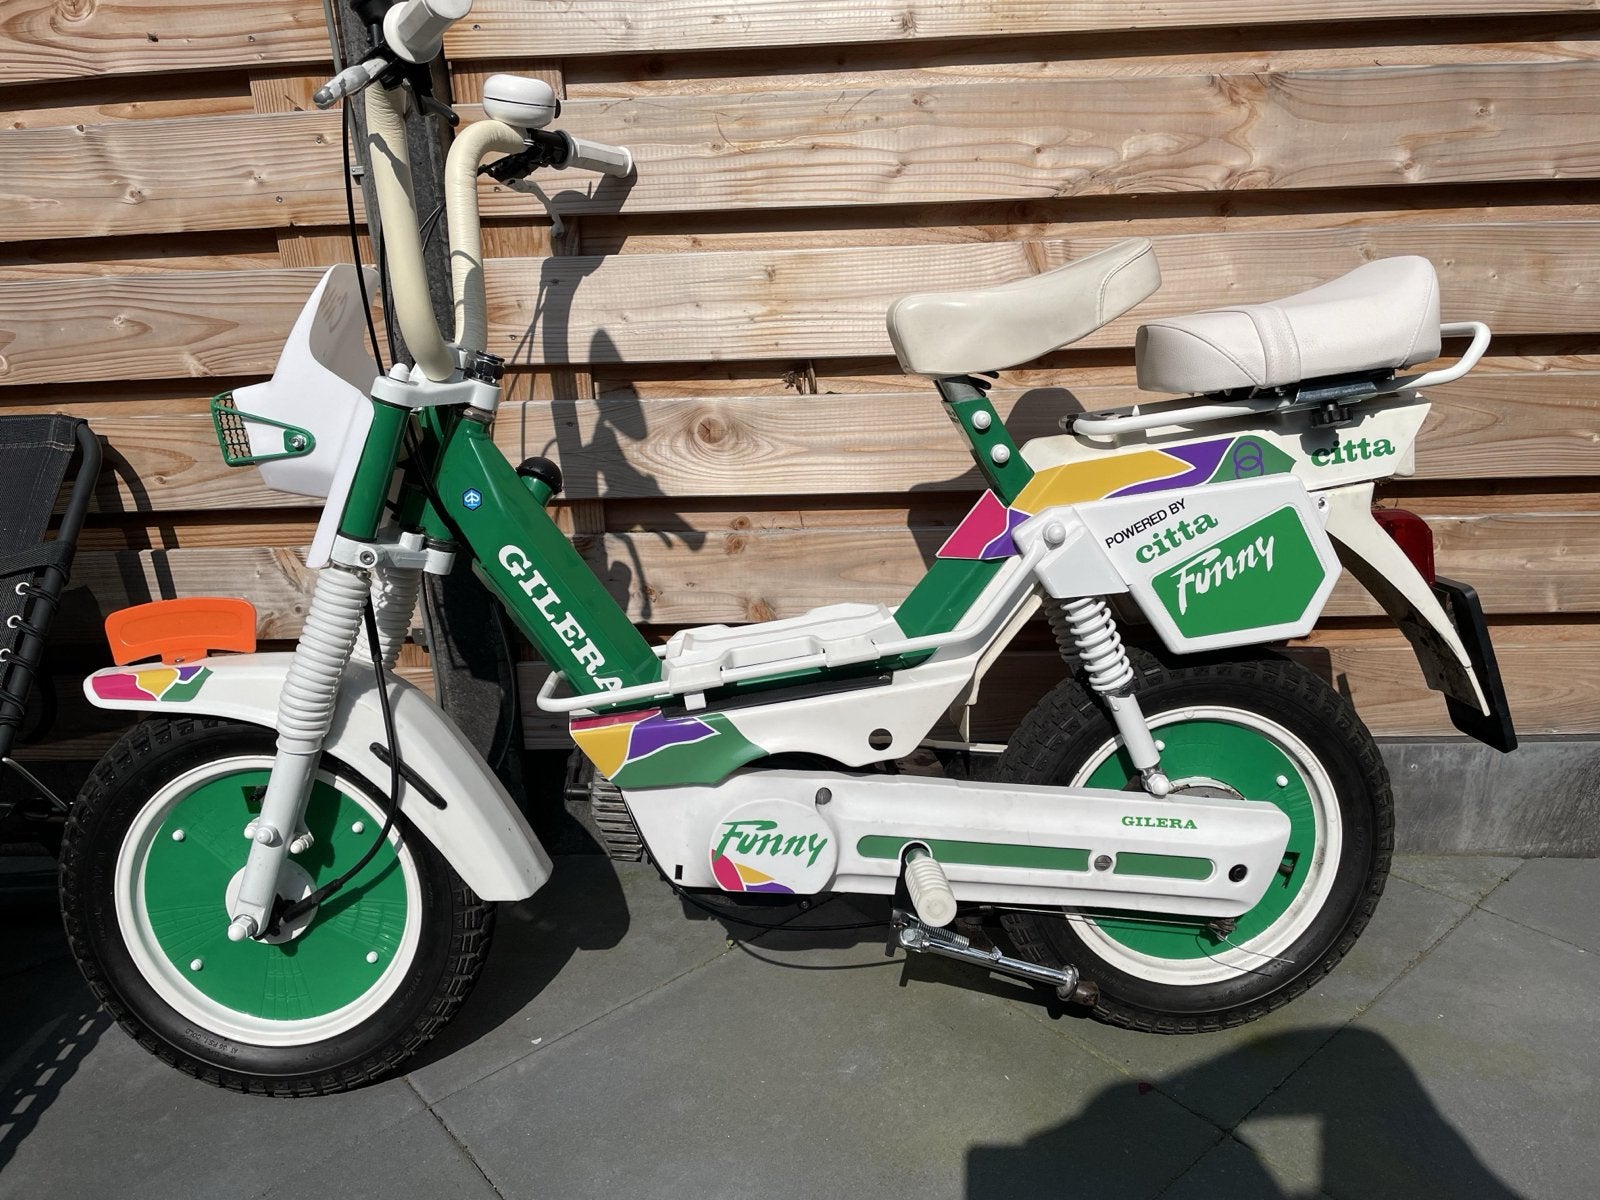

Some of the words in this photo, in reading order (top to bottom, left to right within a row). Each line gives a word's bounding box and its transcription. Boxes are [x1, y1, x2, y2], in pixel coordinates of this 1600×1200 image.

[1311, 438, 1395, 467] citta
[1105, 508, 1168, 549] POWERED
[1168, 498, 1187, 518] BY
[1136, 510, 1218, 564] citta
[1170, 535, 1275, 616] Funny
[713, 820, 828, 868] Funny
[1121, 815, 1198, 829] GILERA
